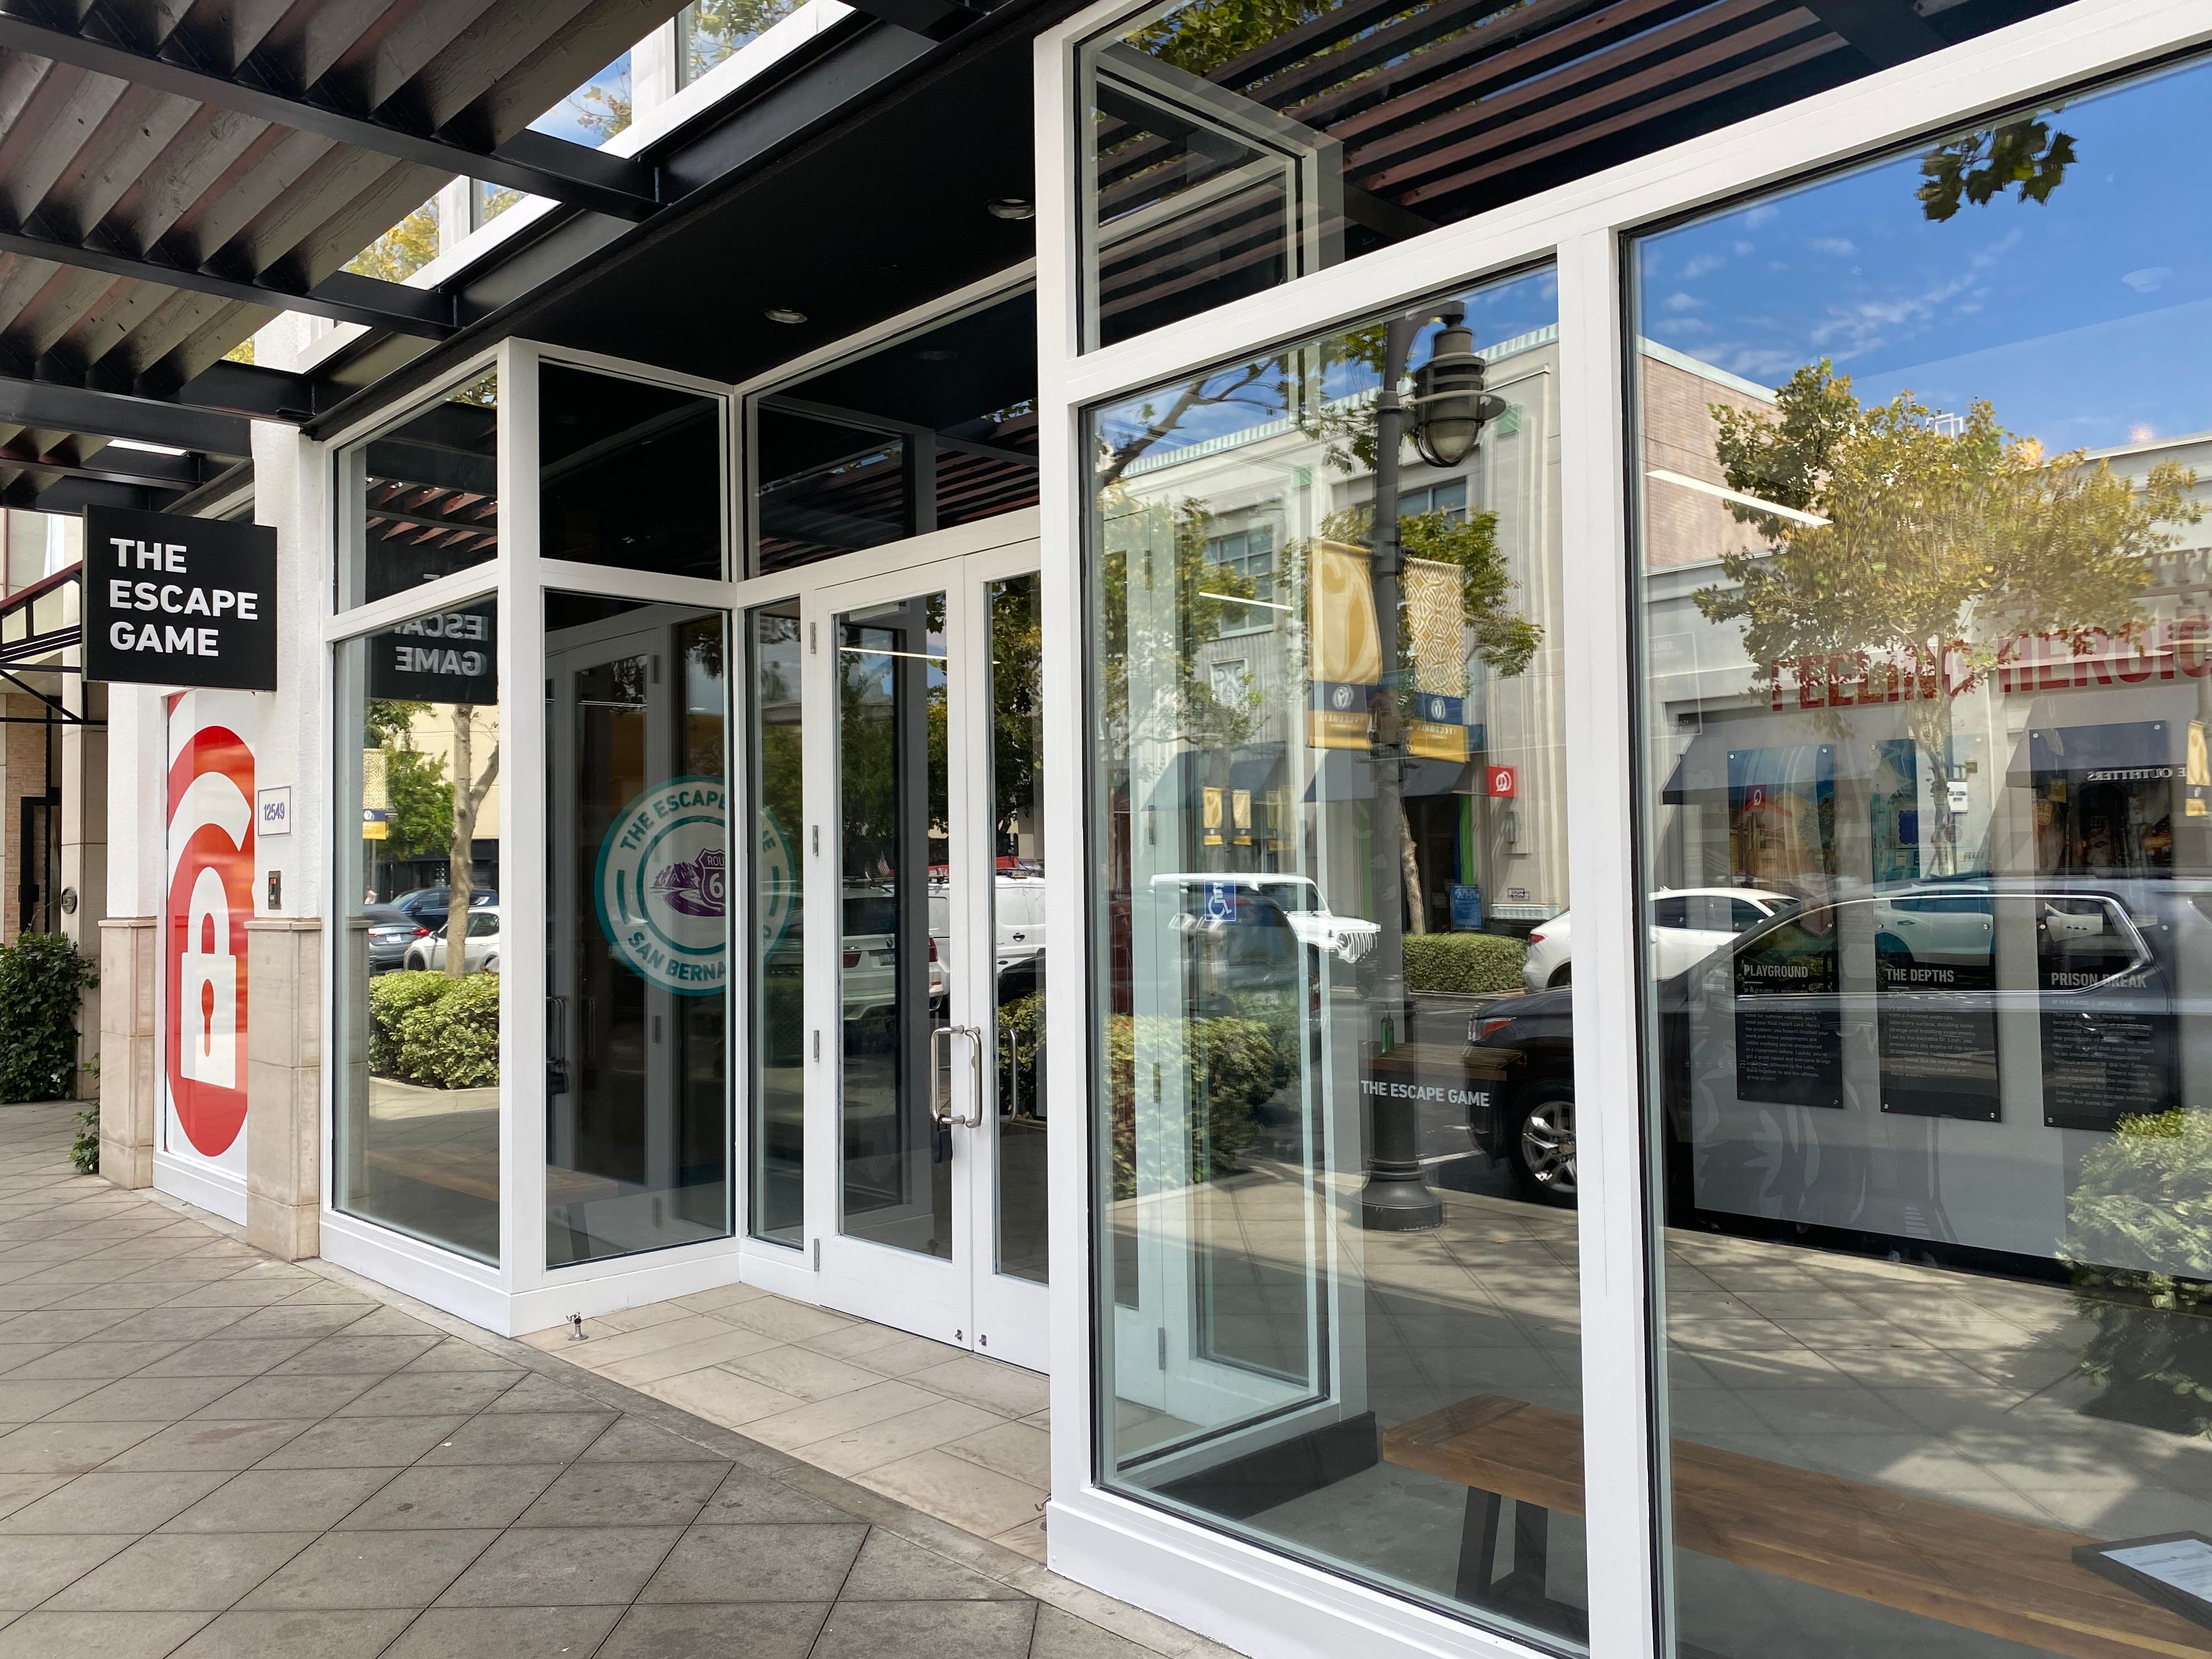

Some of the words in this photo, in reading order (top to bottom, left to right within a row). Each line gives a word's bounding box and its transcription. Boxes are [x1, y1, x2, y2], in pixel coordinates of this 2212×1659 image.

[110, 538, 187, 574] THE
[110, 579, 258, 620] ESCAPE
[110, 622, 219, 657] GAME
[1771, 641, 1974, 712] FEELING
[1997, 614, 2212, 693] HEROIC
[264, 802, 285, 821] 12549
[620, 811, 654, 850] THE
[707, 855, 725, 865] ROU
[709, 872, 725, 898] 6
[628, 932, 665, 969] SAN
[1743, 964, 1809, 978] PLAYGROUND
[1886, 968, 1907, 981] THE
[1910, 969, 1955, 983] DEPTHS
[2051, 972, 2098, 986] PRISON
[2102, 973, 2147, 988] BREAK
[1361, 1080, 1388, 1096] THE
[1391, 1083, 1445, 1102] ESCAPE
[1448, 1089, 1491, 1107] GAME
